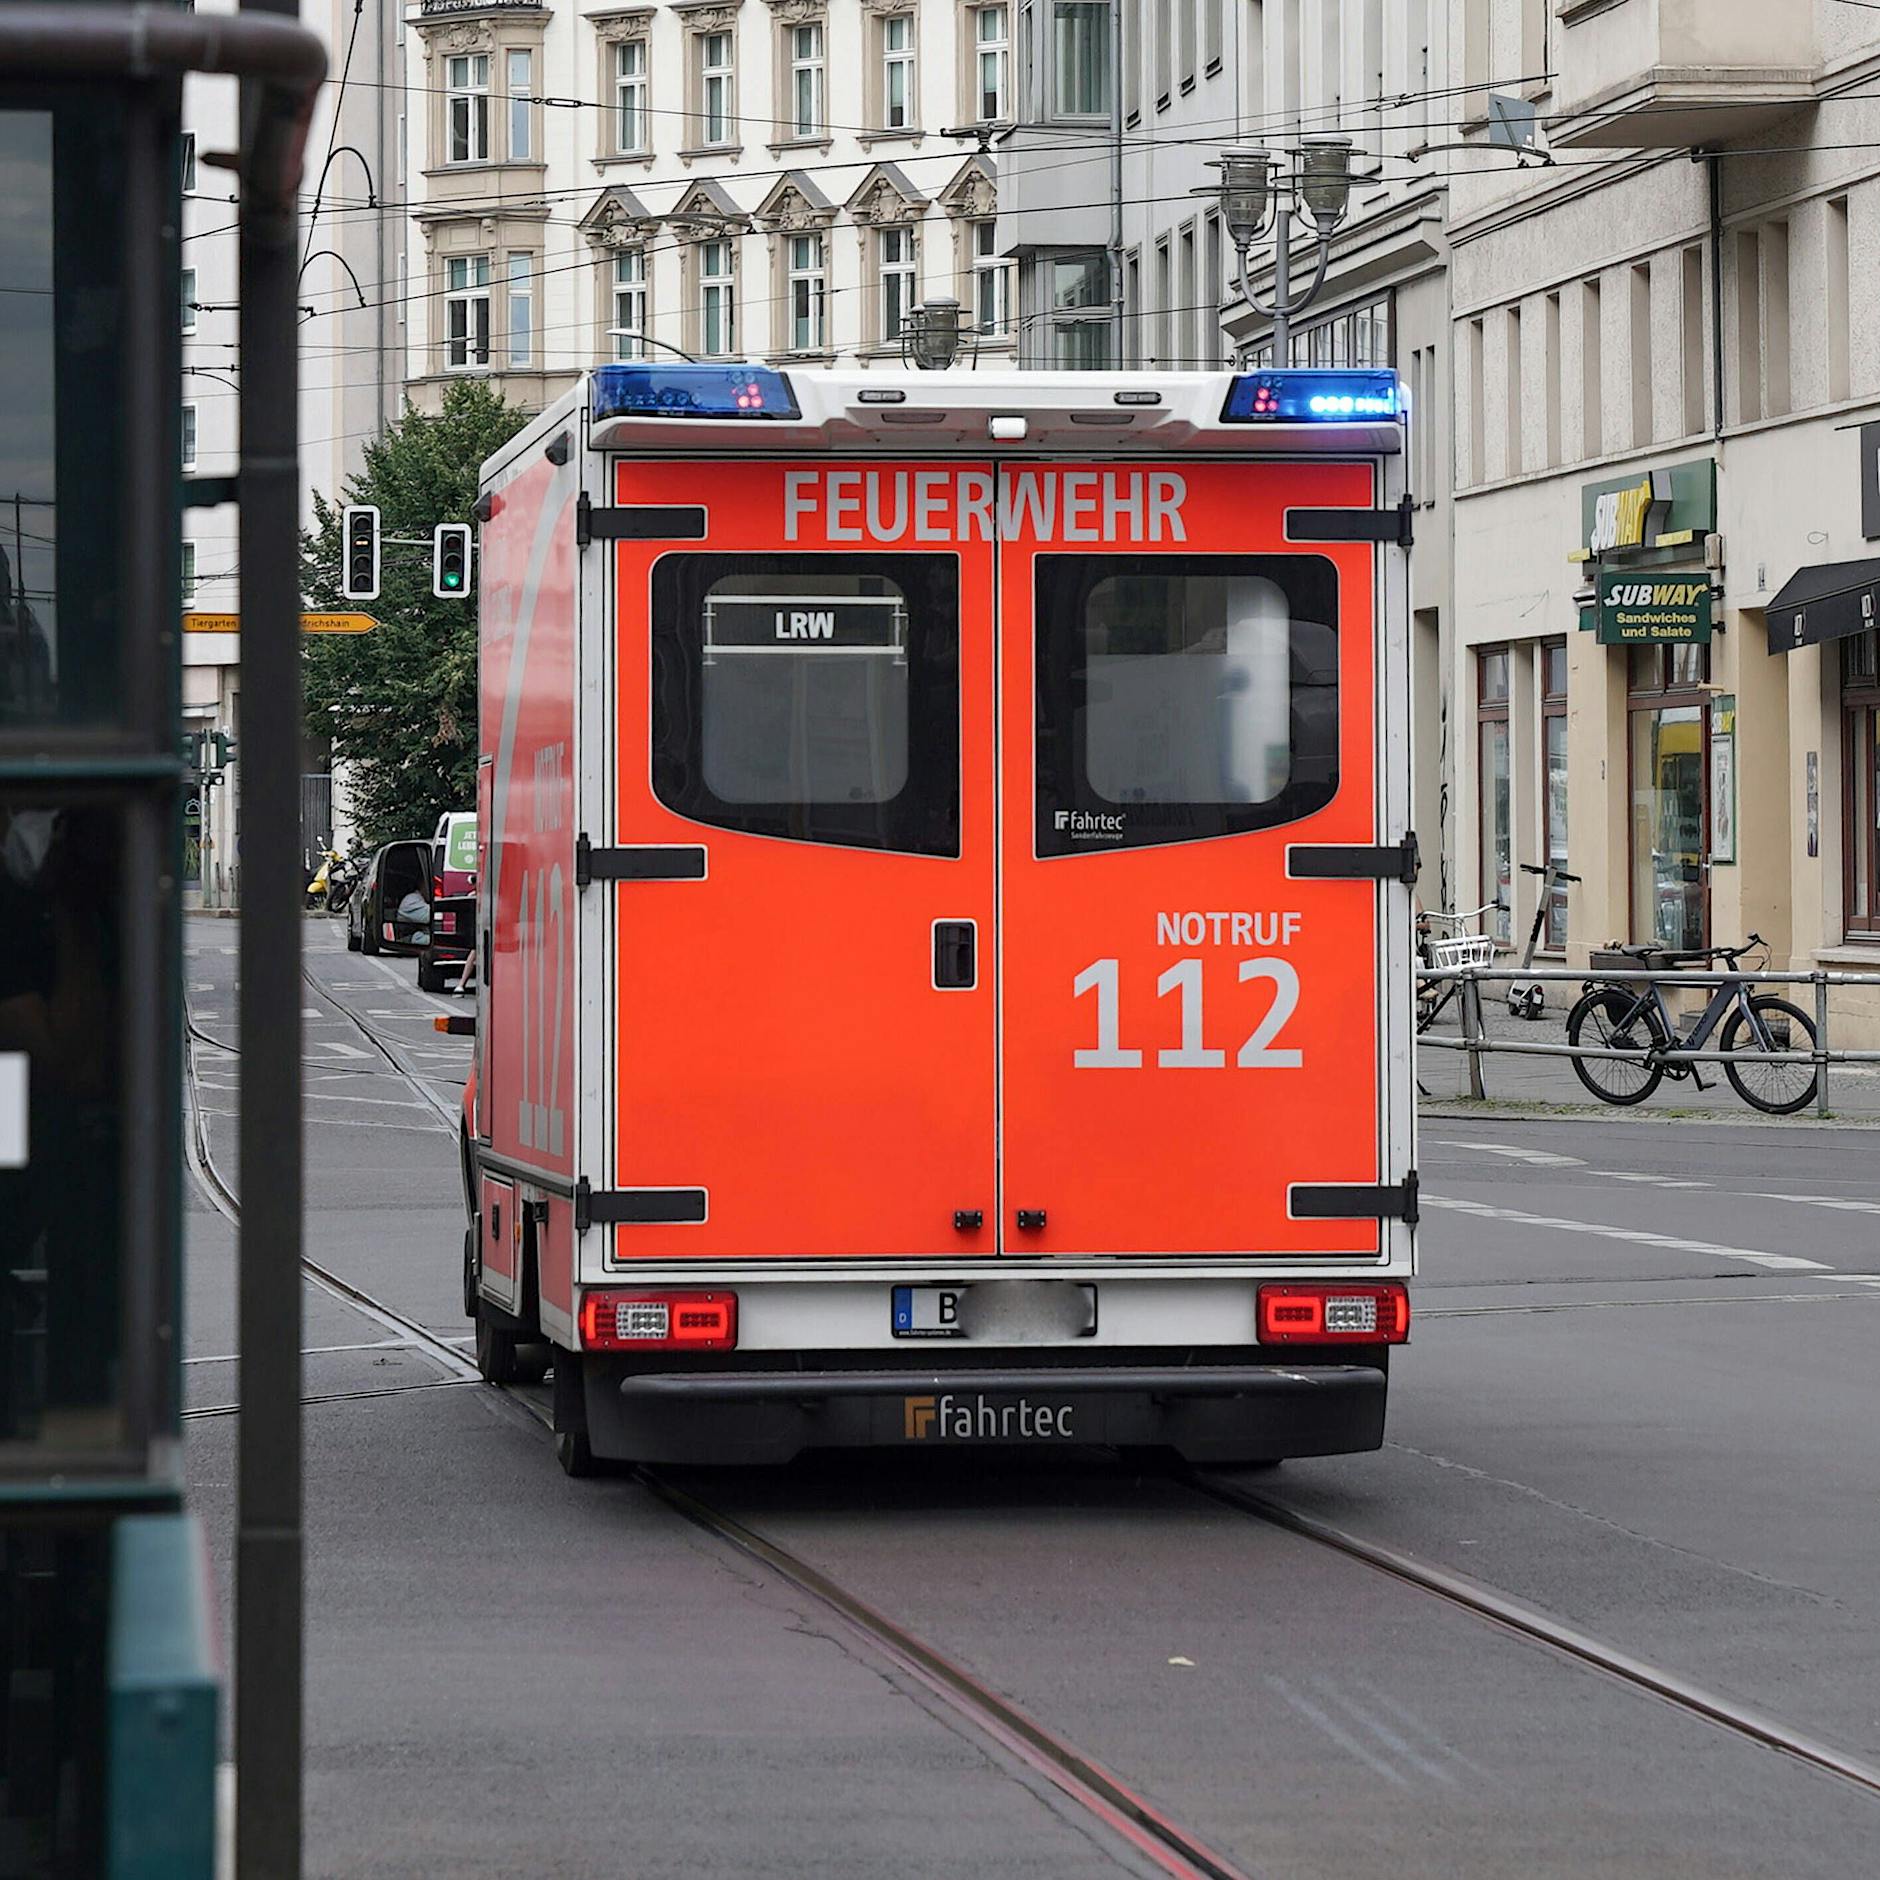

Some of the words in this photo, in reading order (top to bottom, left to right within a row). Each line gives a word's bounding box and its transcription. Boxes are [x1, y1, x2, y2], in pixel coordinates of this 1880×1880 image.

[784, 471, 1187, 542] FEUERWEHR
[1591, 480, 1652, 555] SUBWAY
[1604, 583, 1708, 607] SUBWAY
[191, 618, 237, 629] Tiergarten
[301, 617, 350, 628] drichshain
[775, 612, 835, 639] LRW
[1616, 612, 1697, 624] Sandwiches
[1621, 626, 1647, 637] und
[1650, 626, 1692, 637] Salate
[1071, 811, 1123, 830] fahrtec
[1157, 912, 1302, 945] NOTRUF
[518, 861, 563, 1158] 112
[1074, 957, 1303, 1068] 112
[939, 1292, 958, 1324] B
[940, 1395, 1073, 1437] fahrtec
